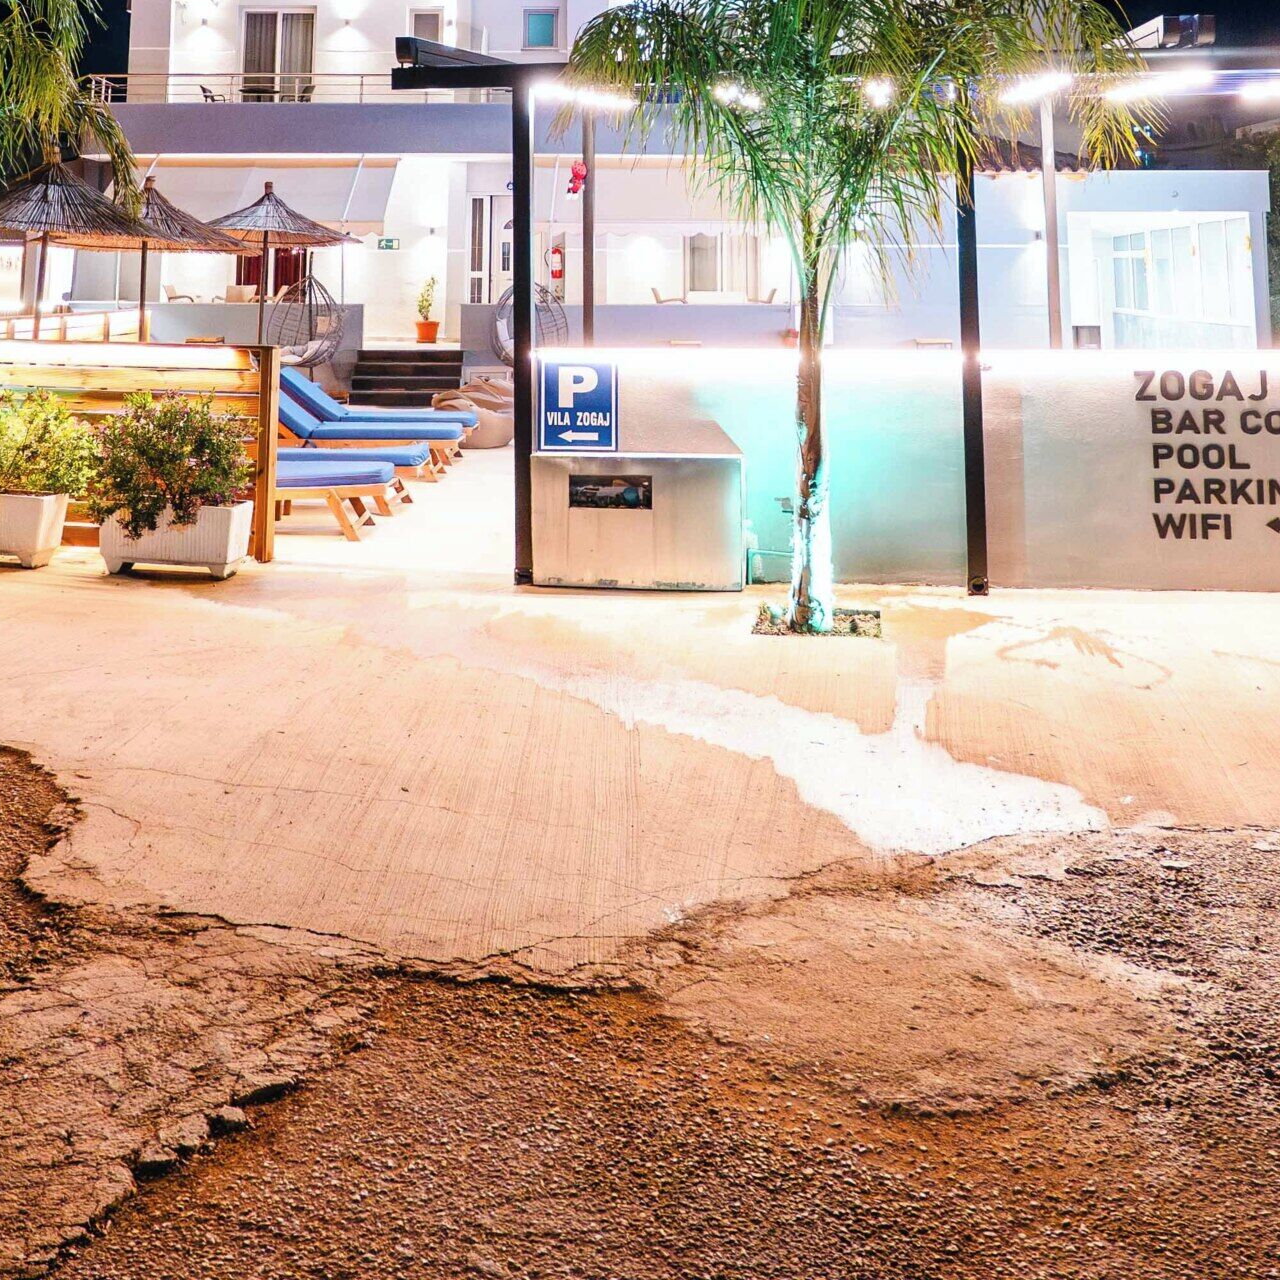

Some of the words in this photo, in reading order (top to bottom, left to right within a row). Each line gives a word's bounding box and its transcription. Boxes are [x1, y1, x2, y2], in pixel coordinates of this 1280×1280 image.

[558, 366, 599, 408] P
[1133, 370, 1268, 402] ZOGAJ
[546, 411, 571, 426] VILA
[576, 411, 610, 427] ZOGAJ
[1150, 408, 1226, 435] BAR
[1152, 443, 1251, 470] POOL
[1152, 513, 1232, 540] WIFI
